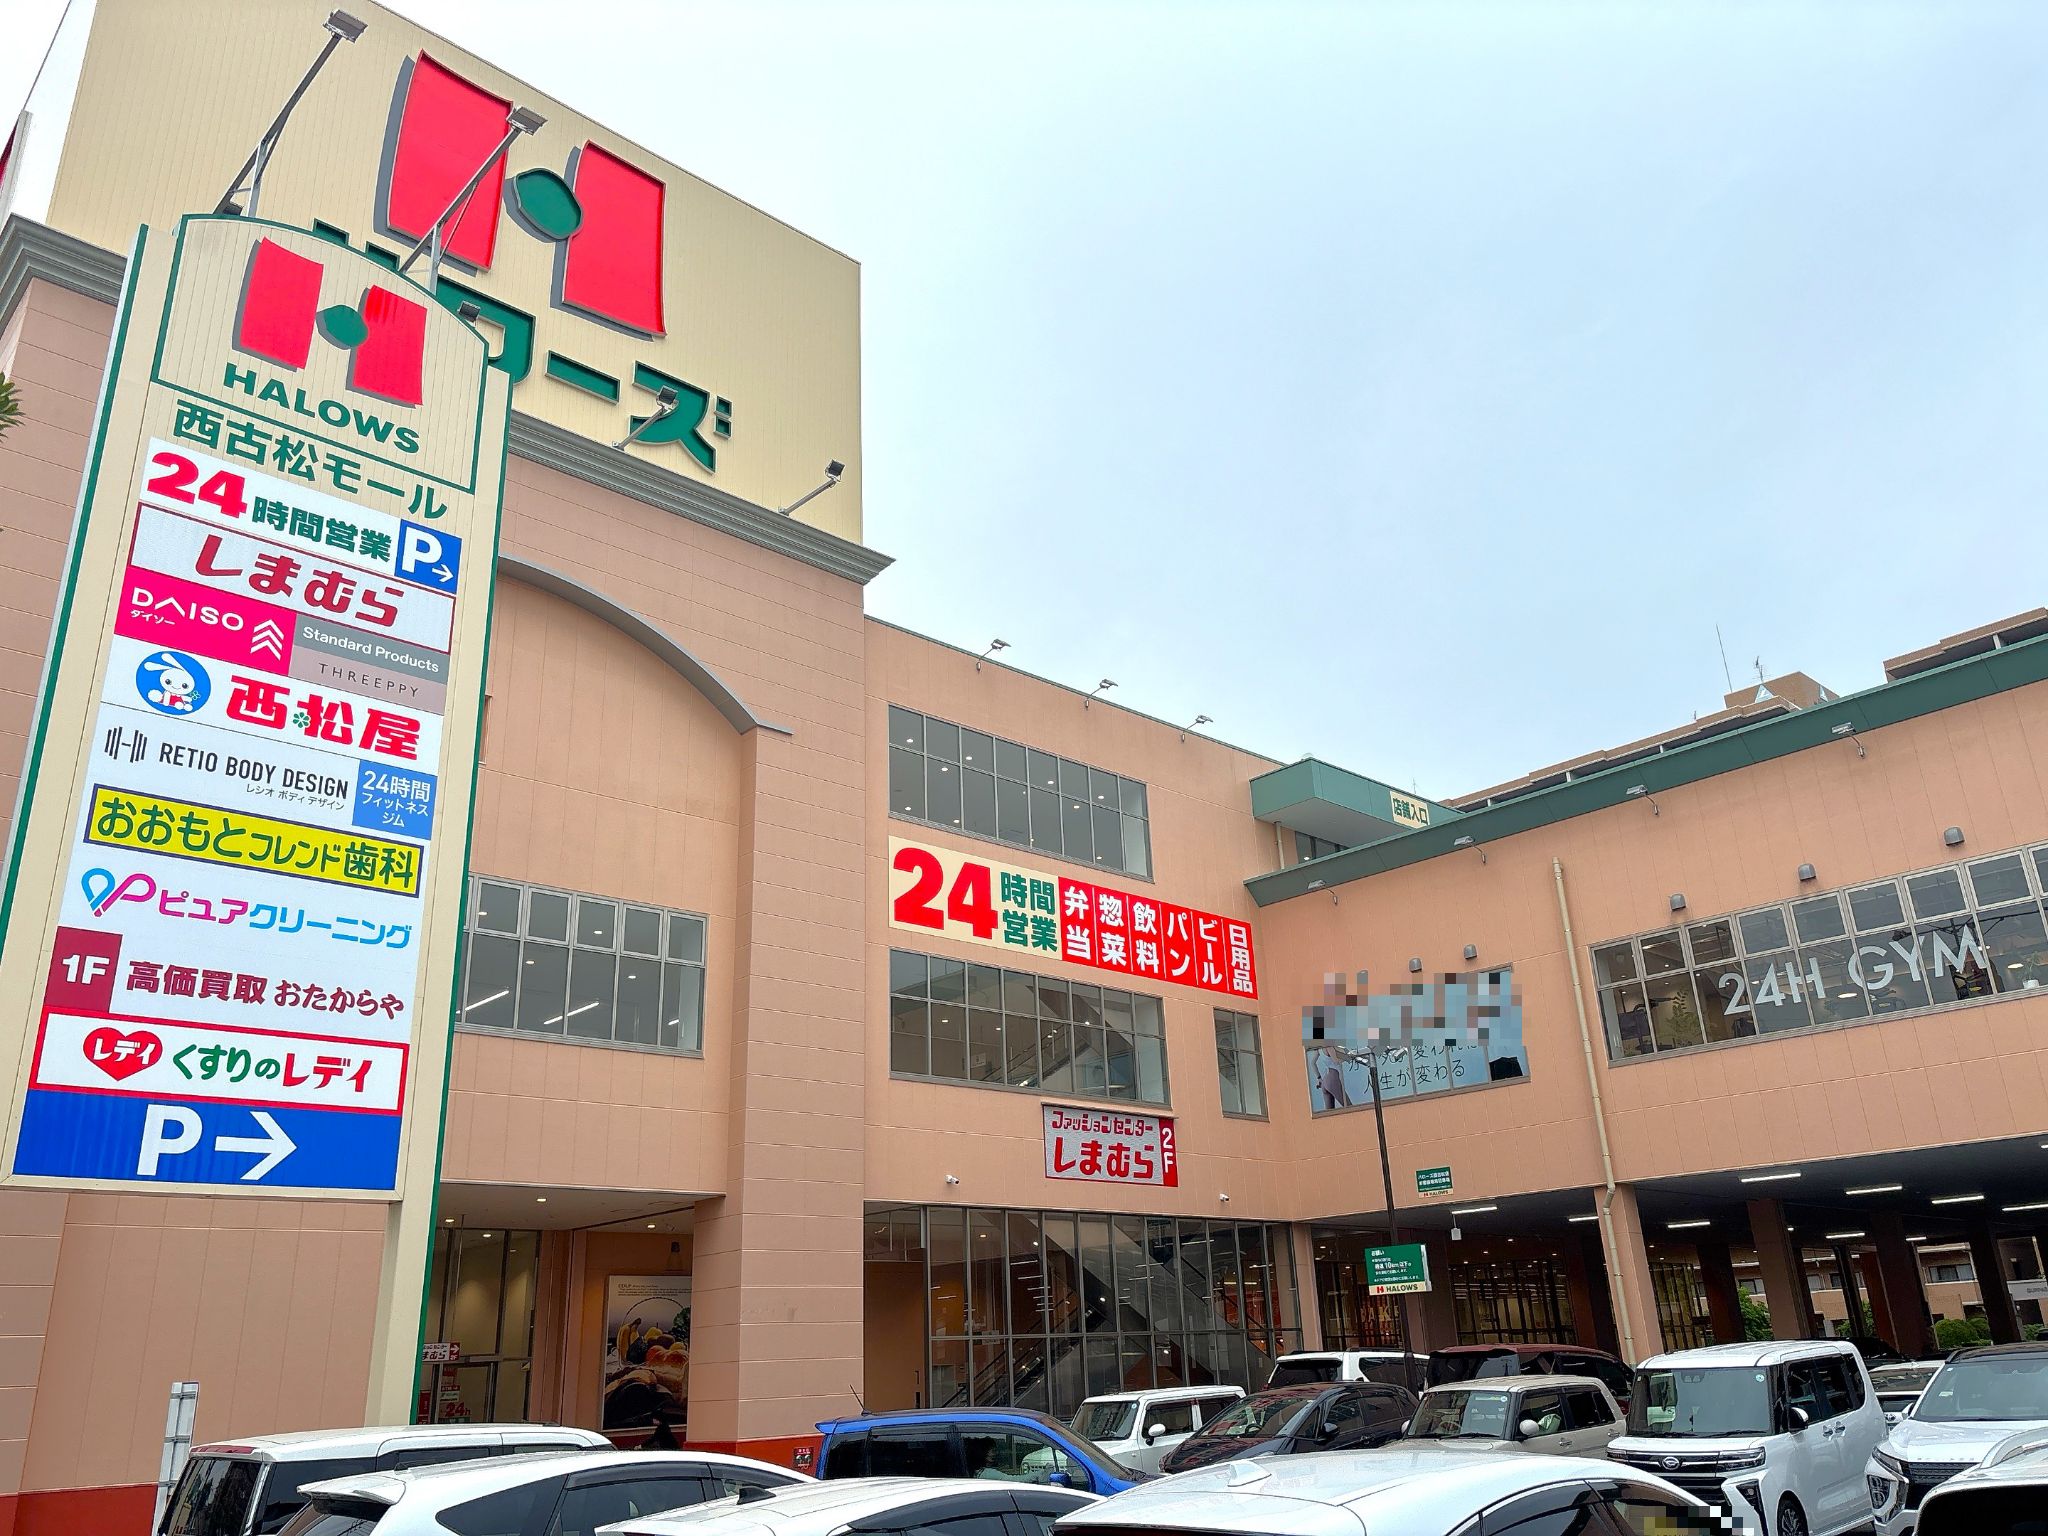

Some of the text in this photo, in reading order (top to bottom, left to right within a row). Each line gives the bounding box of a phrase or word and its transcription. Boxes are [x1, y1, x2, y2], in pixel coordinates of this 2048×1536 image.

[223, 363, 421, 454] HALOWS
[173, 398, 449, 520] 西古松モール
[195, 535, 405, 627] しまむら
[402, 532, 443, 574] P
[130, 609, 175, 626] ダイソー
[131, 588, 244, 631] DAISO
[302, 626, 440, 673] Standard Products
[318, 662, 420, 698] THREEPPY
[225, 674, 422, 760] 西松屋
[159, 743, 350, 800] RETIO BODY DESIGN
[246, 783, 275, 797] レシオ
[308, 794, 345, 811] デザイン
[361, 770, 432, 803] 24時間
[361, 792, 430, 817] フィットネス
[382, 813, 406, 828] ジム
[96, 797, 414, 886] おおもとフレンド歯科
[158, 889, 413, 949] ピュアクリーニング
[893, 847, 999, 940] 24
[1063, 886, 1092, 961] 弁当
[1098, 892, 1127, 968] 惣菜
[1132, 901, 1160, 975] 飲料
[1166, 912, 1191, 978] パン
[1198, 917, 1223, 986] ビール
[1228, 923, 1254, 994] 日用品
[61, 954, 110, 985] 1F
[126, 960, 405, 1020] 高価買取 おたからや
[1717, 924, 1988, 1016] 24H GYM
[136, 1104, 204, 1176] P
[1051, 1110, 1154, 1137] ファッションセンター
[1162, 1126, 1174, 1175] 2F
[1054, 1134, 1154, 1179] しまむら
[1386, 1284, 1418, 1292] HALOWS
